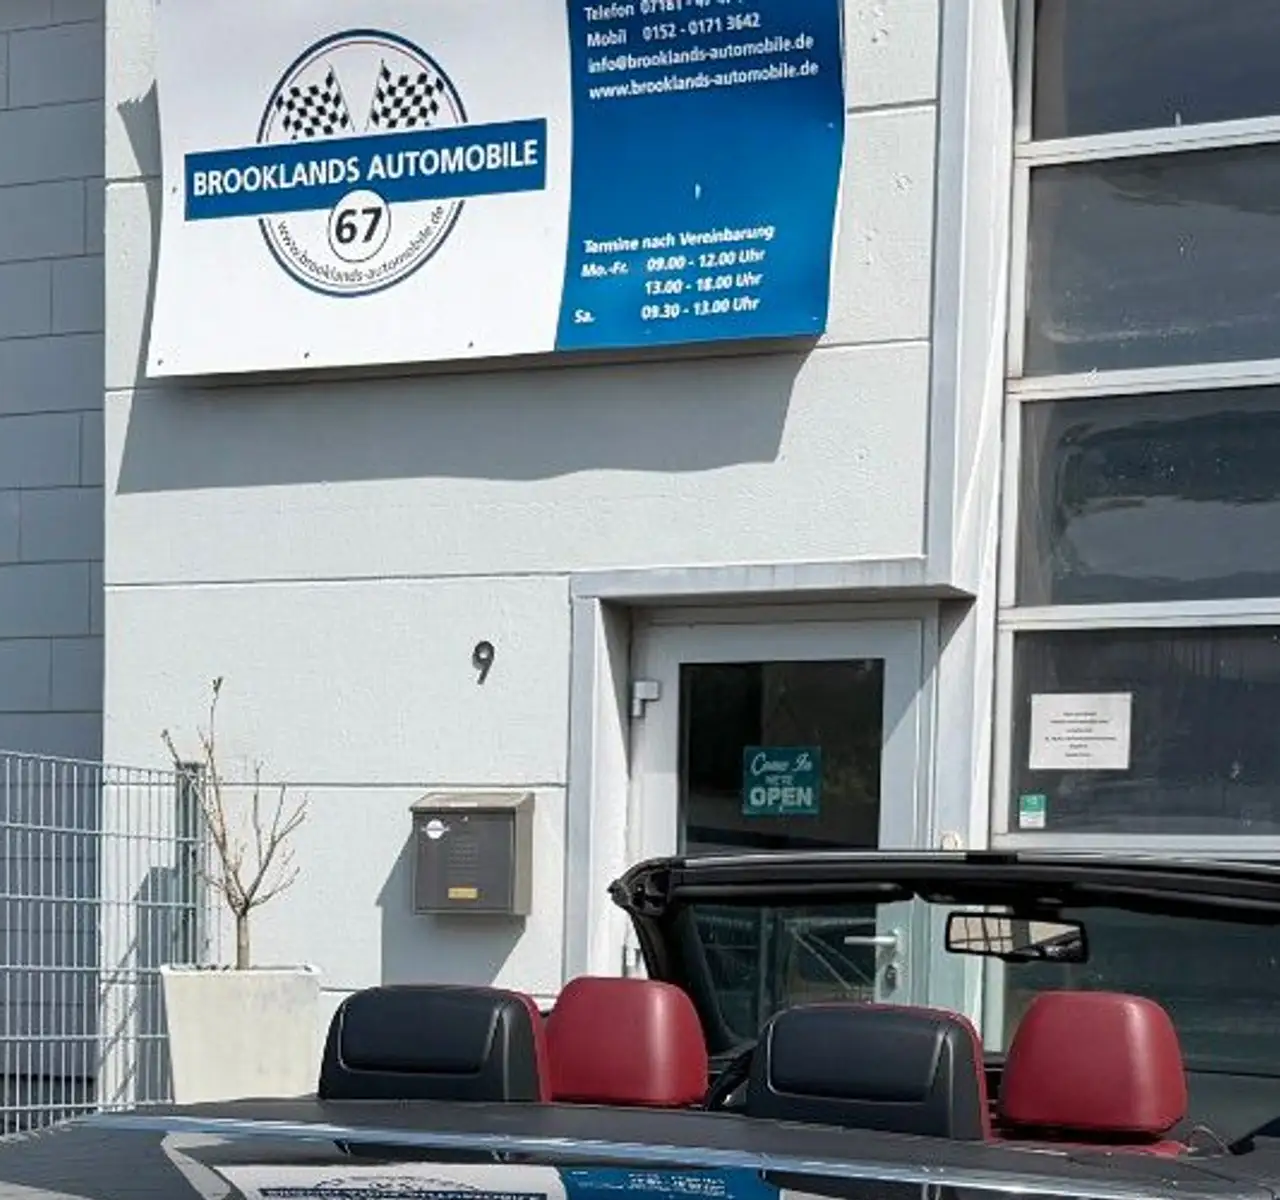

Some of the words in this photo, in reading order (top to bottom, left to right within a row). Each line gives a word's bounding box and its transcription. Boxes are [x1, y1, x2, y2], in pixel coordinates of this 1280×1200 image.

[584, 2, 635, 20] Telefon
[587, 30, 627, 47] Mobil
[642, 24, 677, 41] 0152
[688, 17, 722, 36] 0171
[726, 12, 761, 31] 3642
[588, 33, 814, 73] info@brooklands-automobile.de
[589, 60, 819, 99] www.brooklands-automobile.de
[193, 156, 360, 197] BROOKLANDS
[366, 139, 538, 180] AUTOMOBILE
[335, 206, 382, 244] 67
[583, 238, 639, 254] Termine
[642, 234, 675, 249] nach
[679, 225, 775, 246] Vereinbarung
[581, 261, 629, 278] Mo.-Fr.
[646, 255, 686, 272] 09.00
[698, 251, 736, 268] 12.00
[739, 248, 766, 264] Uhr
[645, 279, 682, 295] 13.00
[736, 272, 764, 287] Uhr
[574, 309, 596, 323] Sa.
[693, 299, 730, 316] 13.00
[733, 297, 761, 311] Uhr
[472, 640, 495, 685] 9
[750, 787, 812, 808] OPEN
